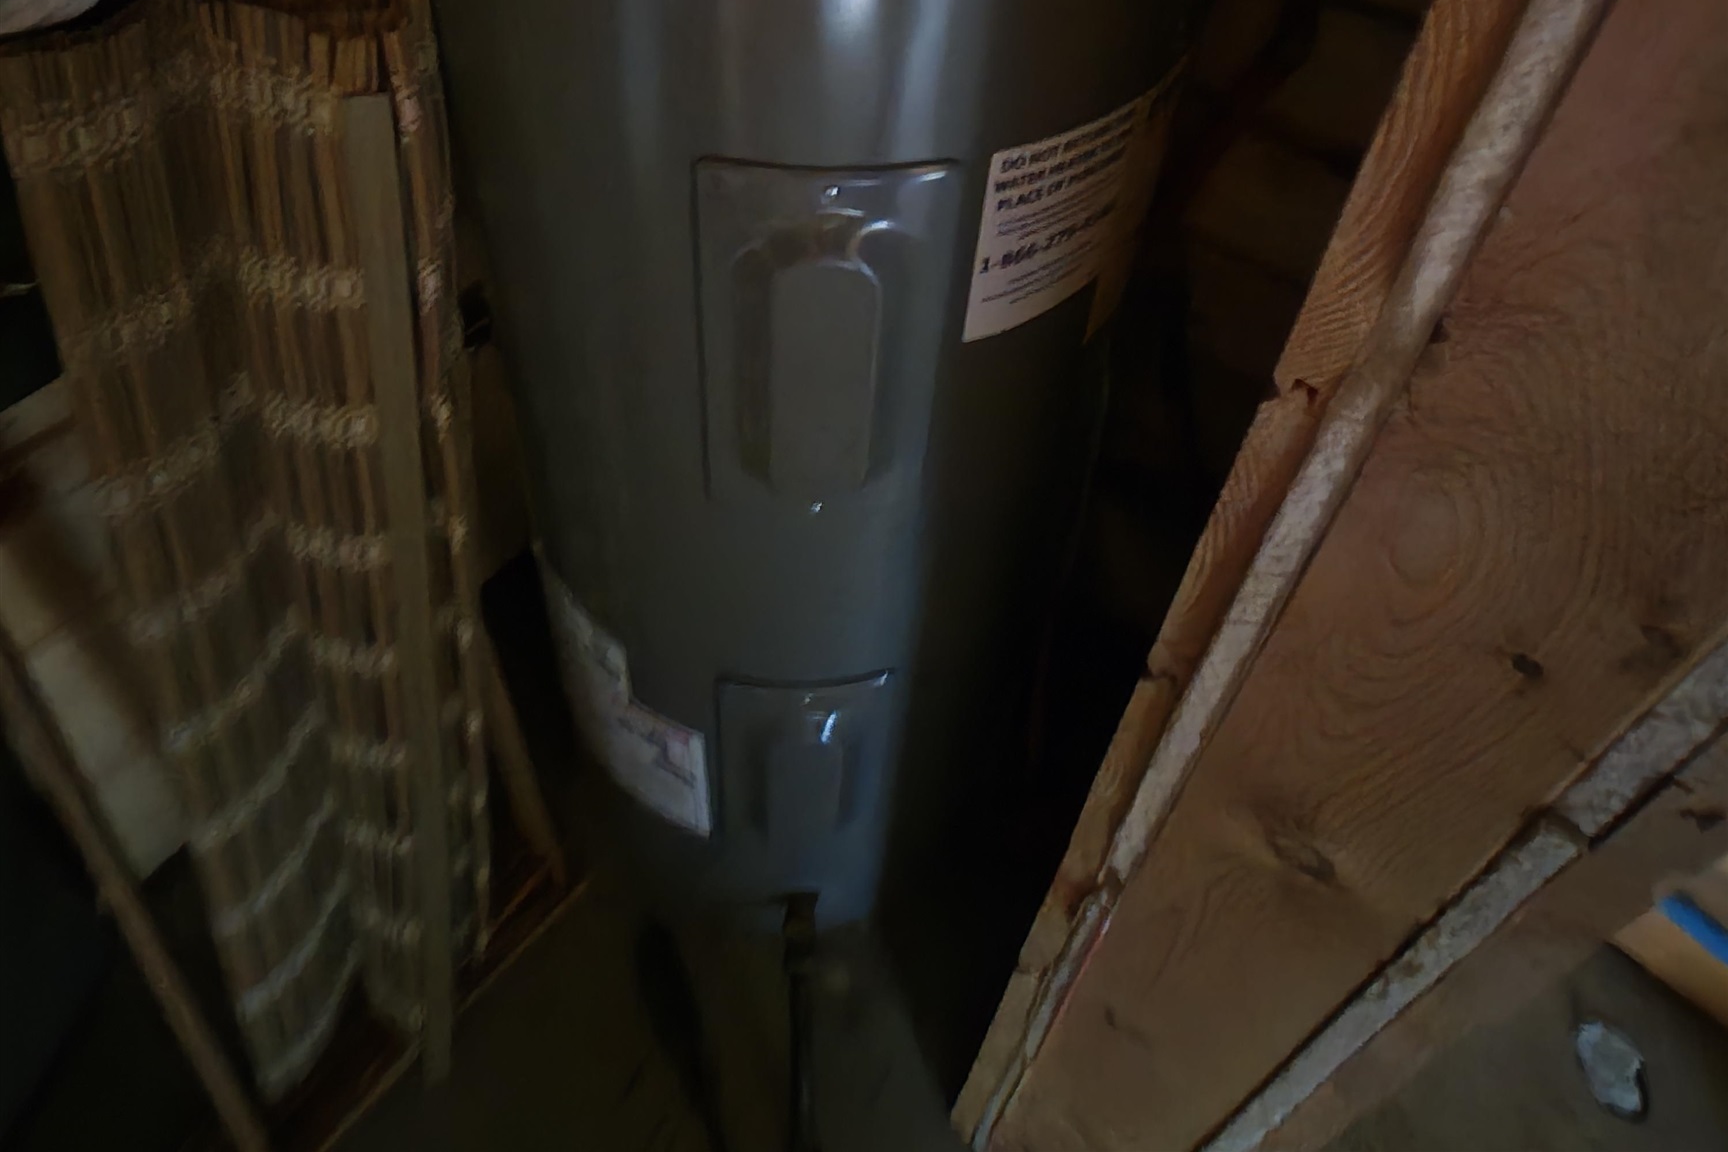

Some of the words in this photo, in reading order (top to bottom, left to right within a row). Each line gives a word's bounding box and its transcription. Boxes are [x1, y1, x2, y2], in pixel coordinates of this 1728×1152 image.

[1001, 153, 1027, 173] DO
[995, 169, 1046, 194] WATER
[997, 187, 1043, 212] PLACE
